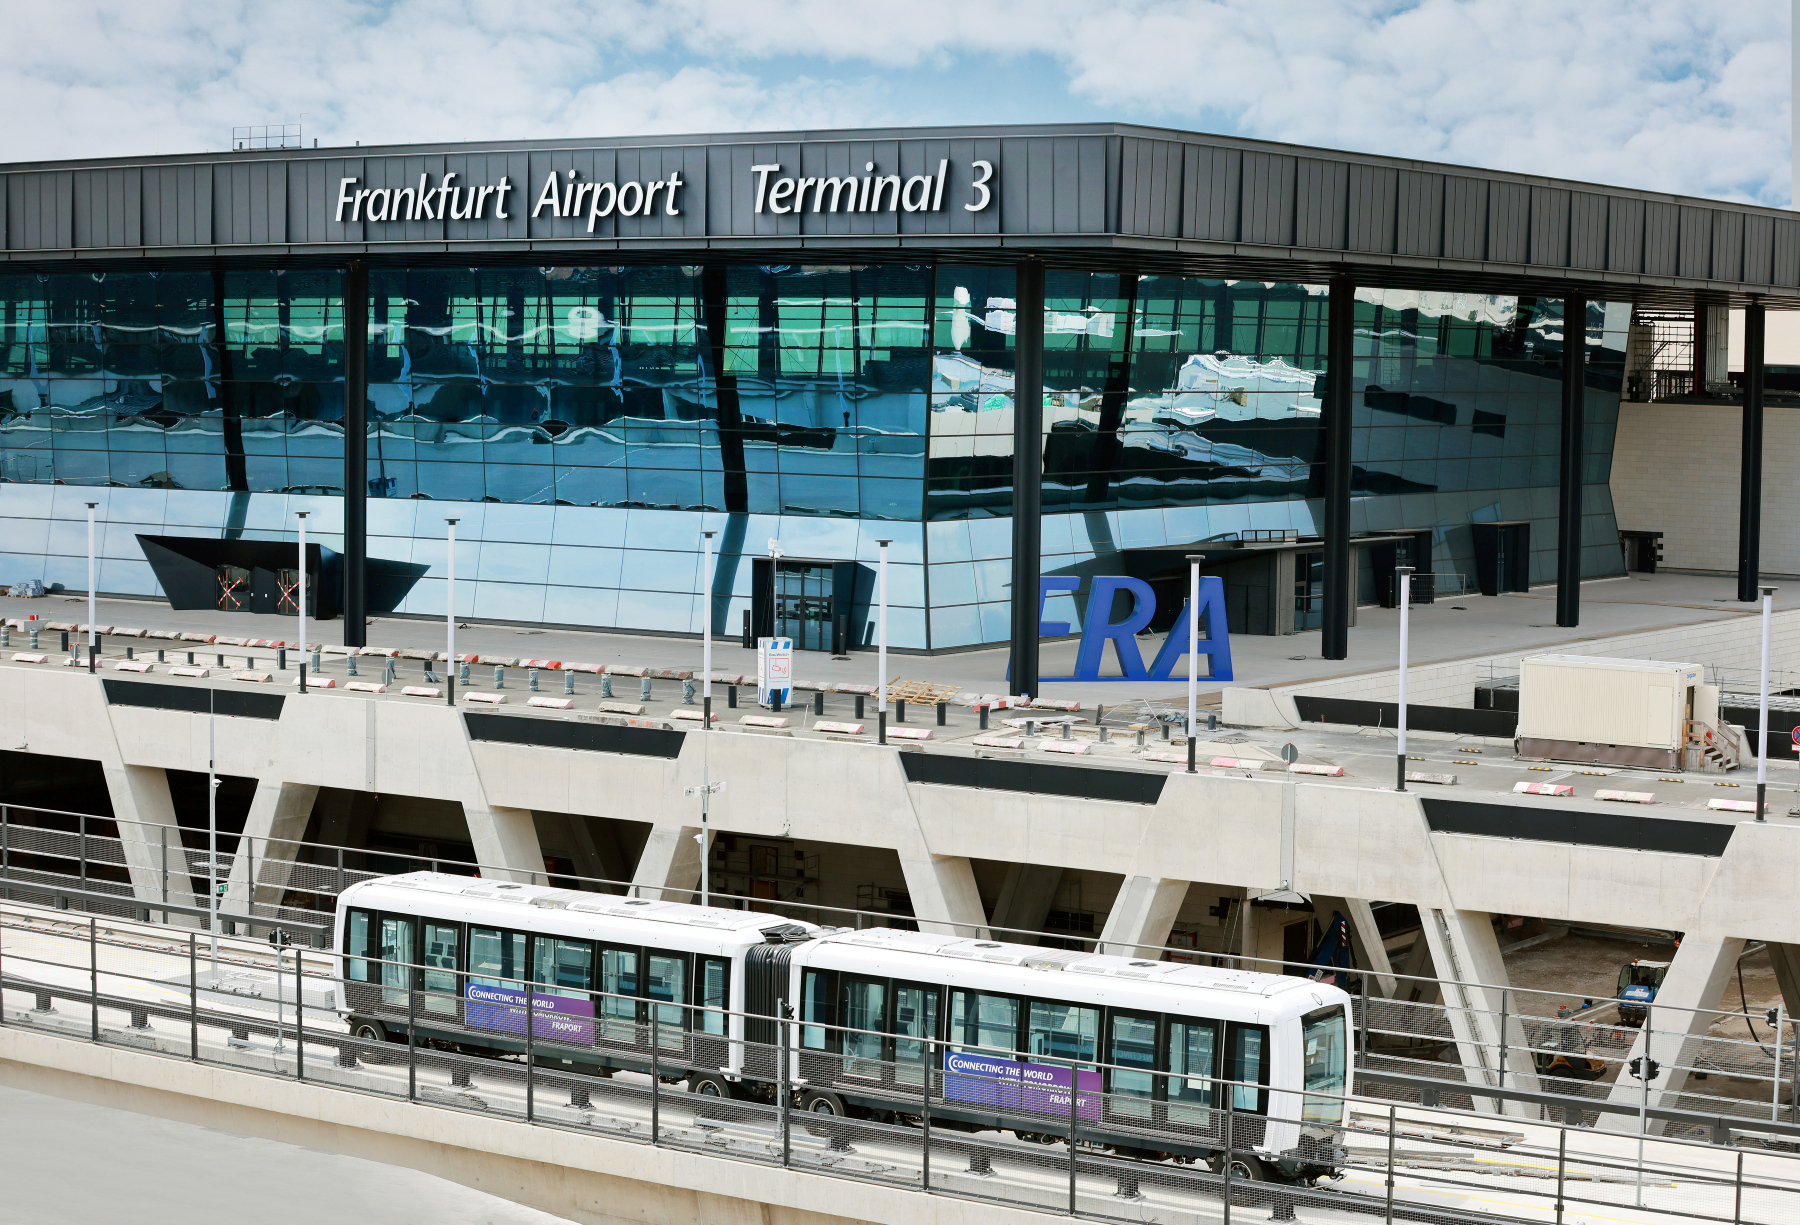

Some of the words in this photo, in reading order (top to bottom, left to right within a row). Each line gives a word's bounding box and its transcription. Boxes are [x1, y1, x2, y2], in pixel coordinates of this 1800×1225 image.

[335, 172, 512, 222] Frankfurt
[531, 169, 683, 233] Airport
[751, 158, 949, 214] Terminal
[964, 160, 994, 212] 3
[470, 988, 514, 1003] CONNECTING
[514, 996, 528, 1005] THE
[551, 1021, 583, 1033] FRAPORT
[951, 1058, 1004, 1075] CONNECTING
[1005, 1066, 1021, 1077] THE
[1023, 1069, 1054, 1081] WORLD
[1049, 1094, 1087, 1107] FRAPRT
